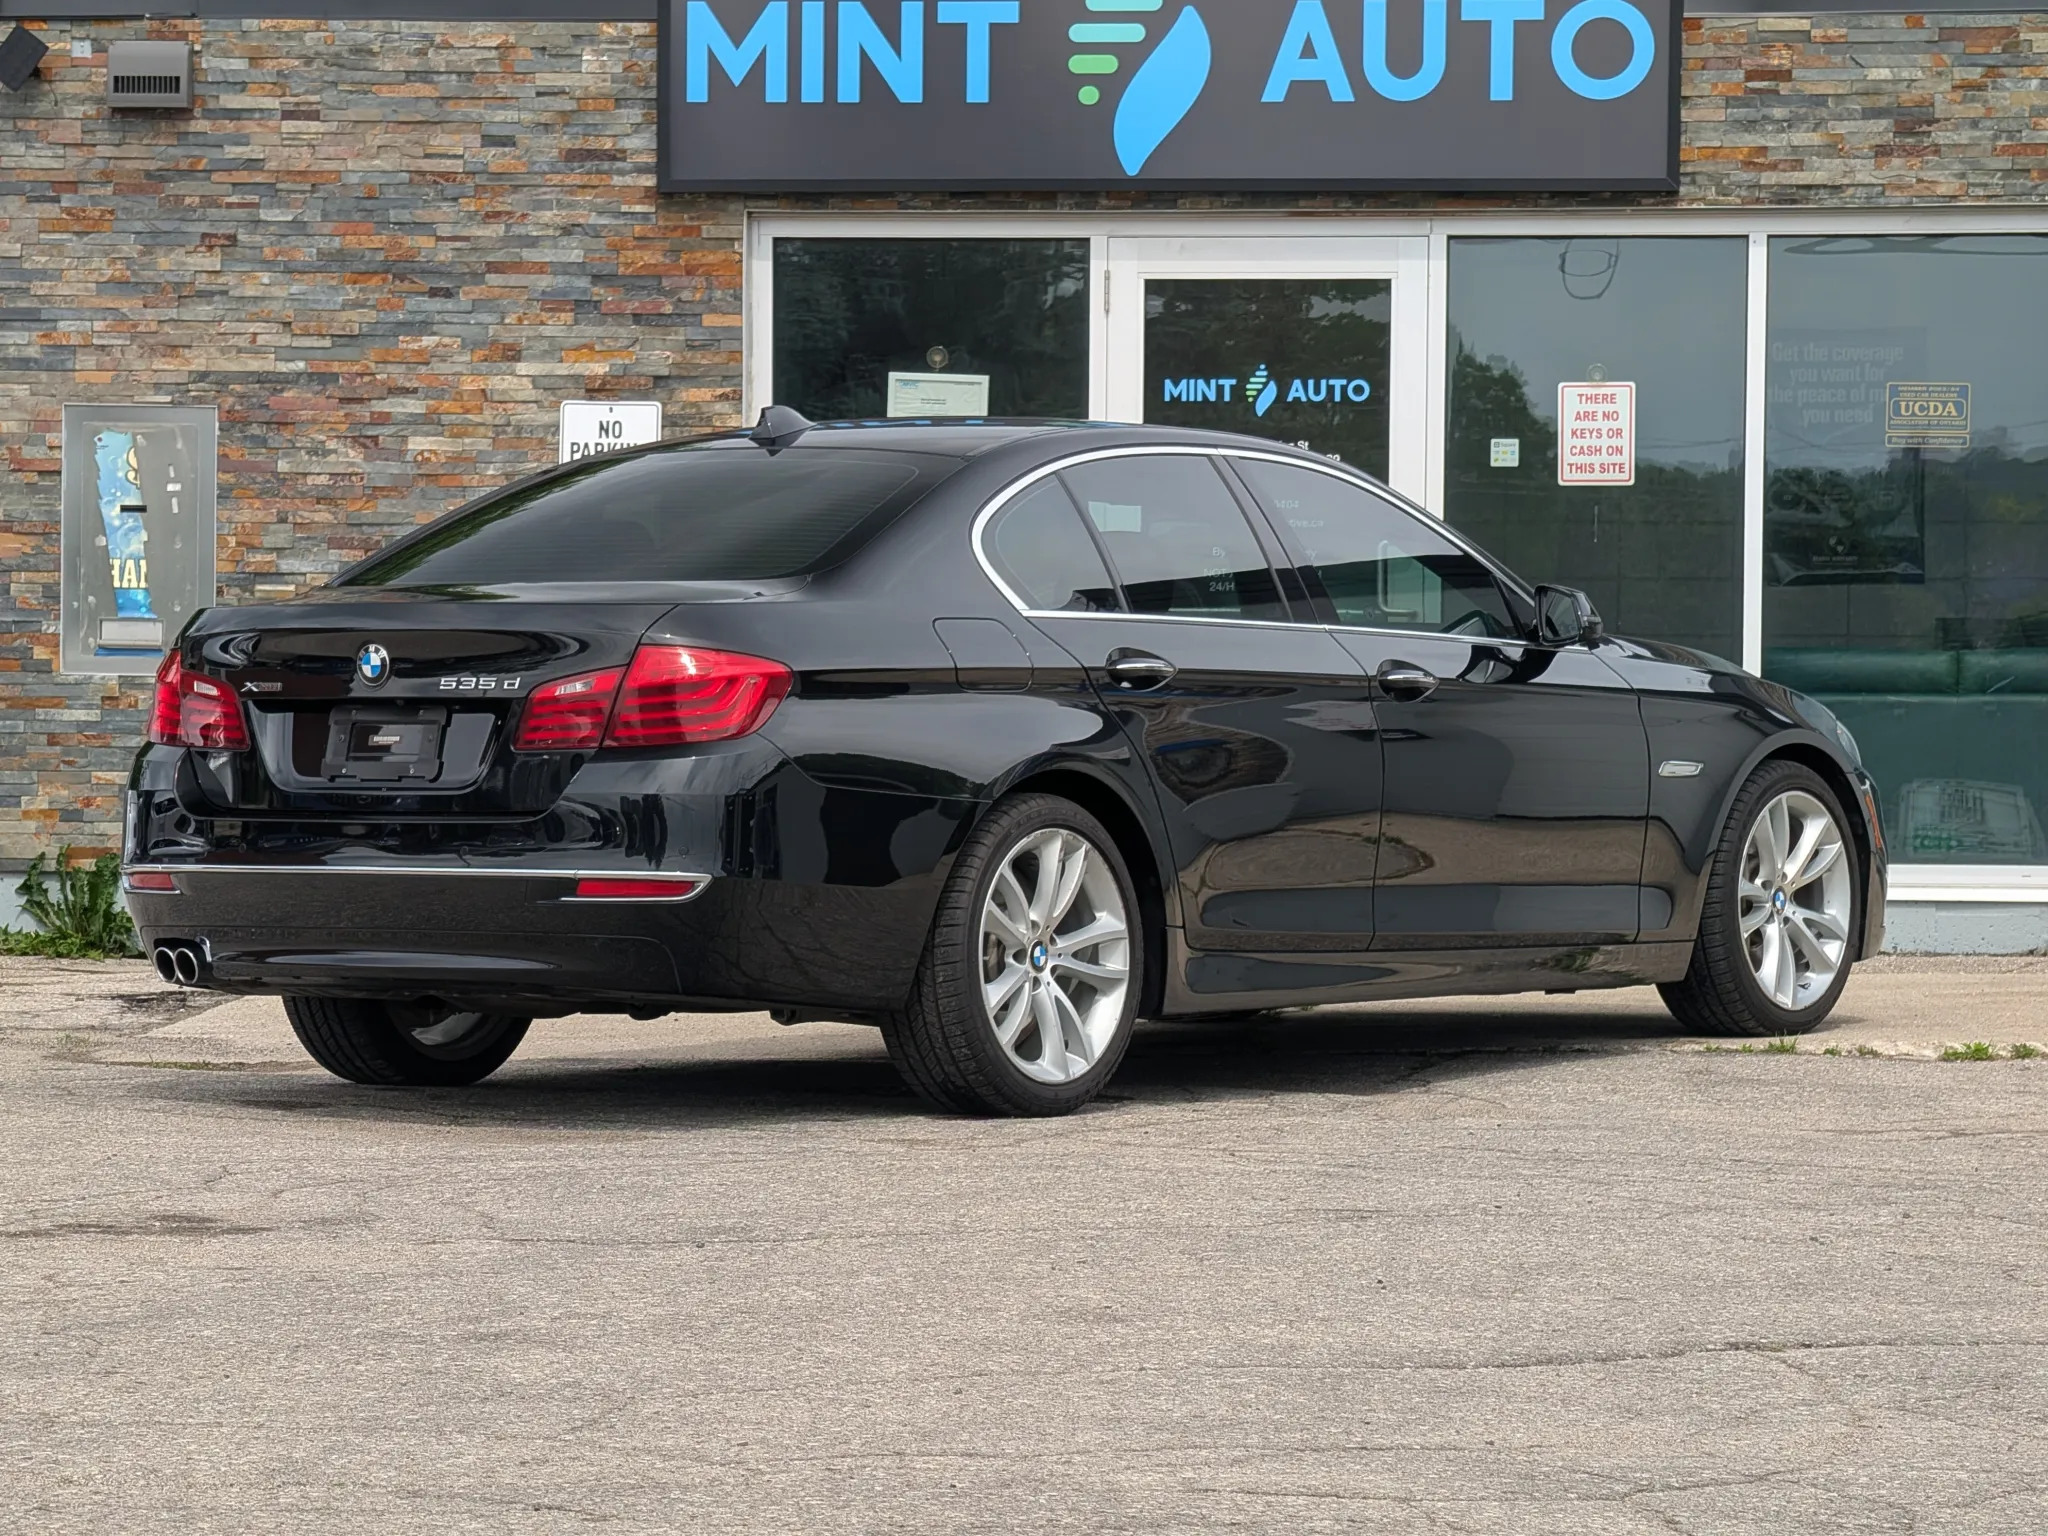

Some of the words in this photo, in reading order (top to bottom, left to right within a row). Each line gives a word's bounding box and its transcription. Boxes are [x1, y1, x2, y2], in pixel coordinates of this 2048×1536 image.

[686, 0, 1020, 104] MINT
[1260, 0, 1656, 104] AUTO
[1772, 342, 1800, 362] Get
[1803, 341, 1829, 362] the
[1832, 345, 1904, 366] coverage
[1789, 368, 1818, 387] you
[1821, 366, 1861, 383] want
[1864, 362, 1888, 382] for
[1163, 378, 1237, 402] MINT
[1286, 378, 1371, 402] AUTO
[1797, 387, 1847, 407] peace
[1850, 383, 1867, 402] of
[1577, 393, 1617, 405] THERE
[1574, 410, 1599, 422] ARE
[1602, 410, 1619, 422] NO
[1802, 408, 1831, 429] you
[1834, 404, 1875, 423] need
[1899, 401, 1958, 417] UCDA
[598, 420, 623, 439] NO
[1571, 427, 1603, 440] KEYS
[1606, 427, 1624, 440] OR
[1570, 445, 1602, 457] CASH
[1606, 445, 1624, 457] ON
[1567, 462, 1595, 474] THIS
[1599, 462, 1626, 474] SITE
[439, 677, 498, 690] 535
[503, 677, 521, 690] d
